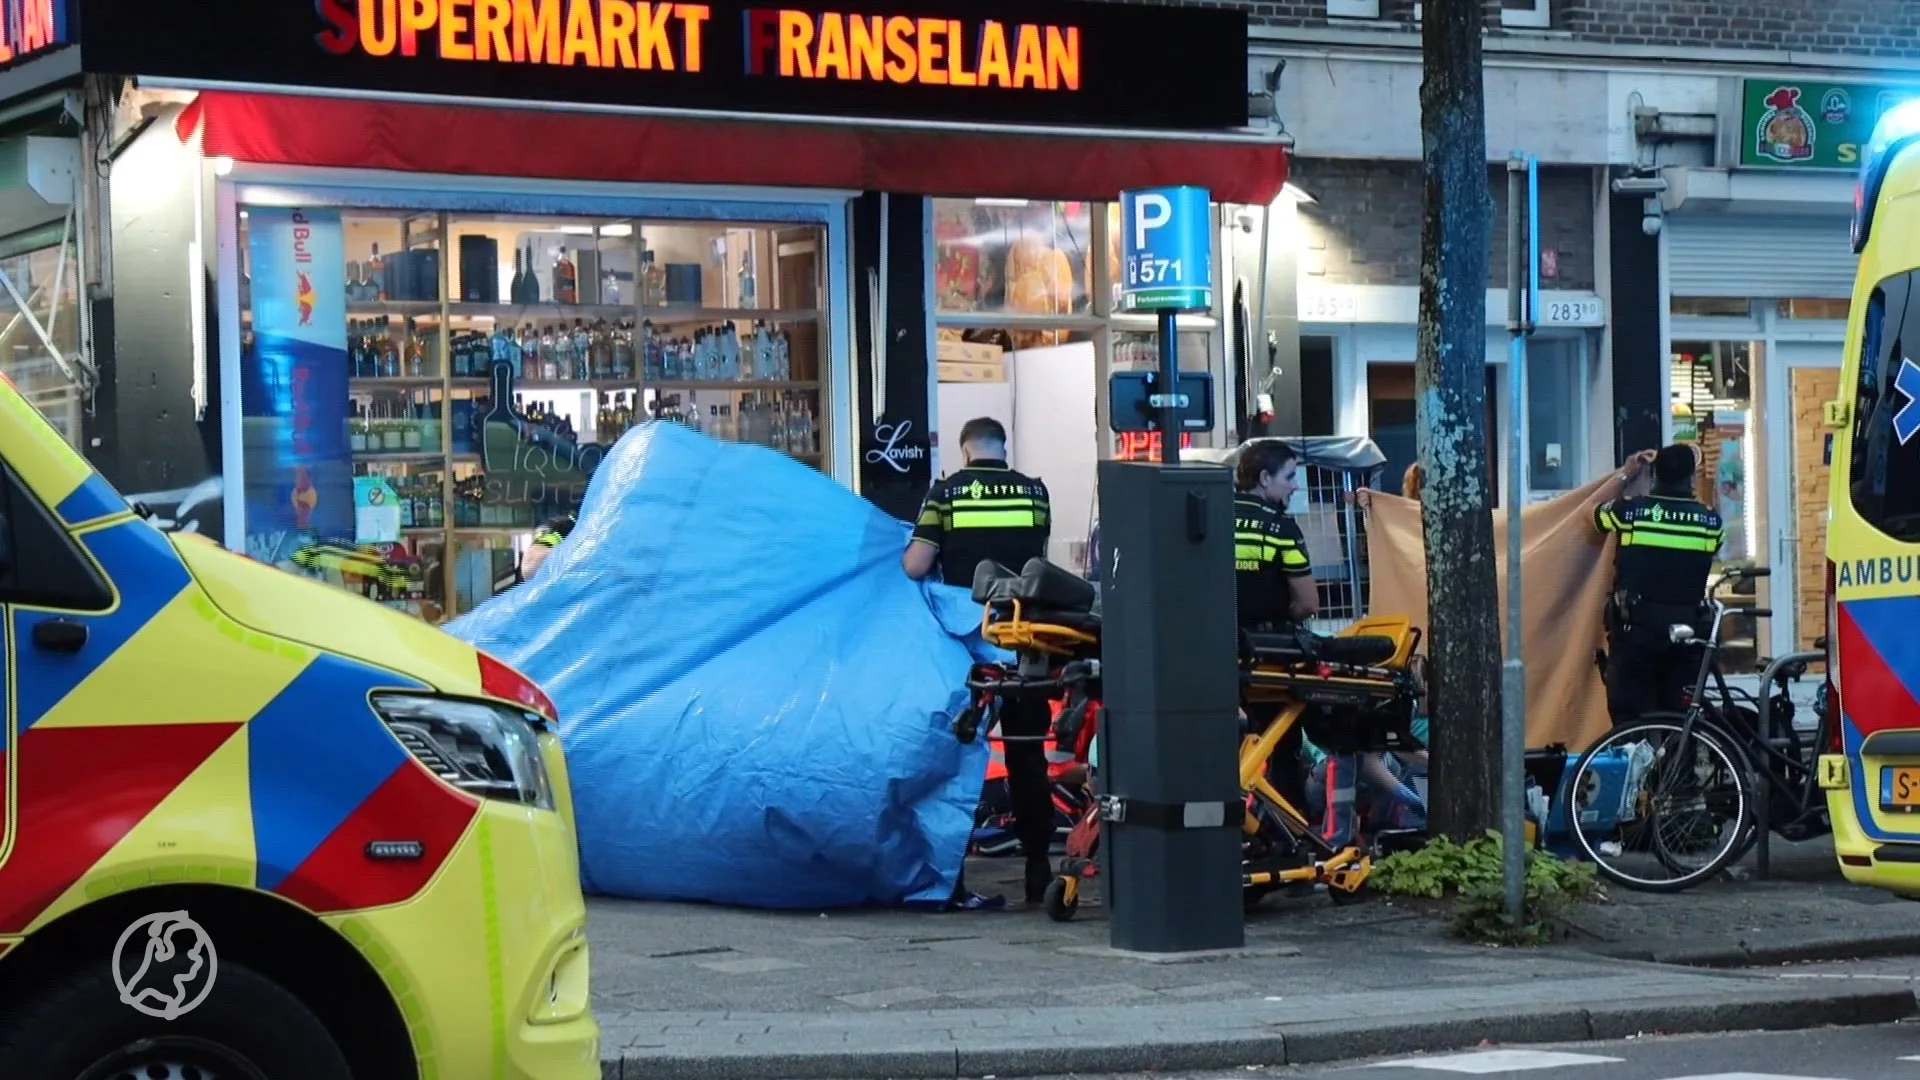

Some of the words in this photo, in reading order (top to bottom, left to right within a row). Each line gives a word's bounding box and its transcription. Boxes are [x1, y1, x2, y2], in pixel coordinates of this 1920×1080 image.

[315, 0, 710, 72] SUPERMARKT
[743, 8, 1080, 91] FRANSELAAN
[1135, 193, 1172, 250] P
[293, 227, 312, 263] Bull
[1140, 258, 1182, 283] 571
[1551, 303, 1582, 321] 283
[865, 419, 924, 473] Lavish
[1839, 555, 1920, 588] AMBU
